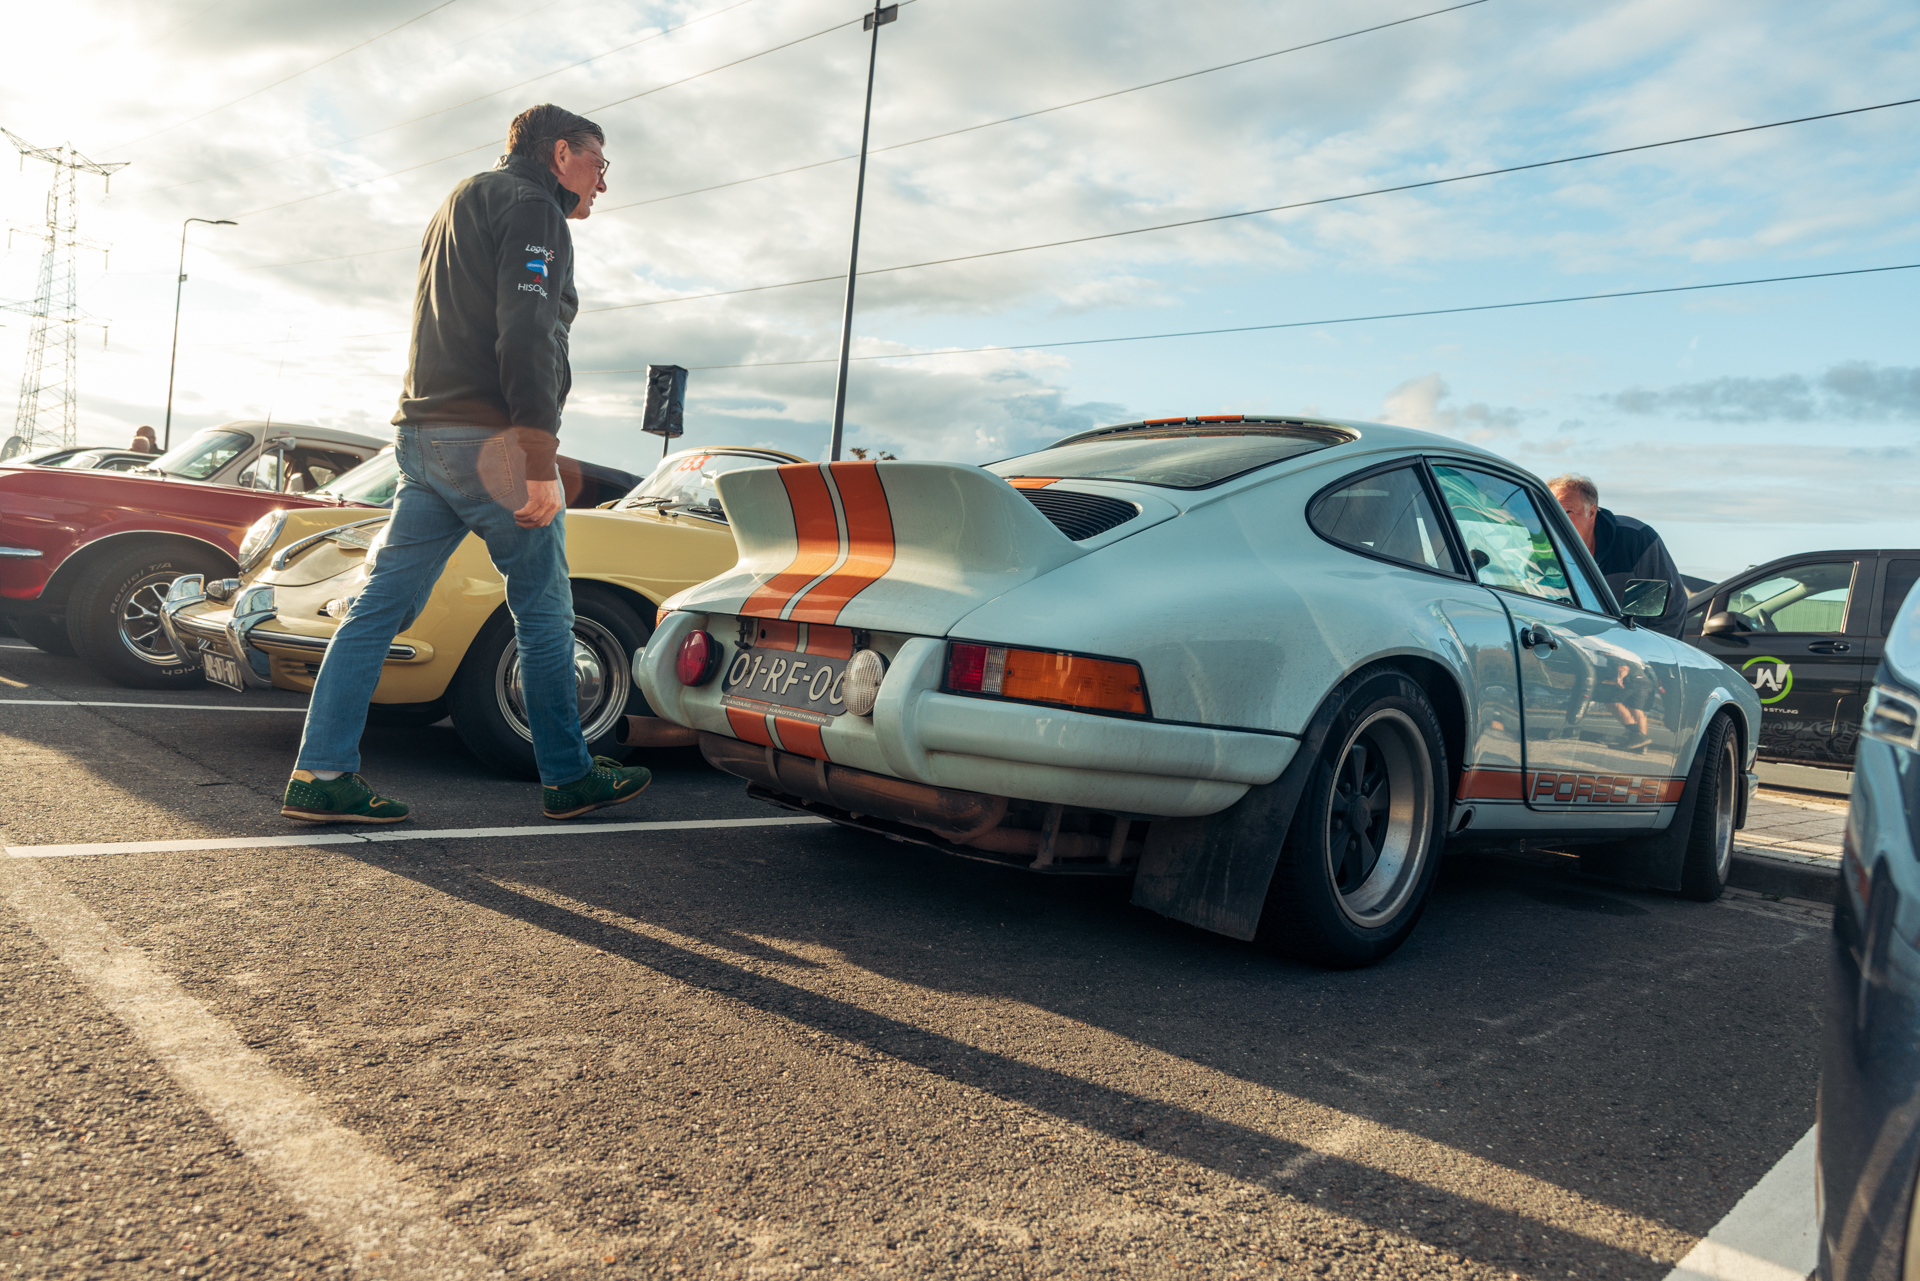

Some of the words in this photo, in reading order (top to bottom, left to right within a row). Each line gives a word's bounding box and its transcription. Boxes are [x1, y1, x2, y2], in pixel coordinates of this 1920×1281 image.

[517, 282, 548, 300] HISCOX
[674, 455, 713, 472] 133
[110, 569, 144, 614] Radial
[149, 562, 172, 571] T/A
[725, 699, 752, 708] VANDAAG
[752, 703, 769, 712] GEEN
[768, 708, 828, 723] HANDTEKENINGEN
[1417, 694, 1446, 757] MICHELIN
[1532, 773, 1660, 803] PORSCHE
